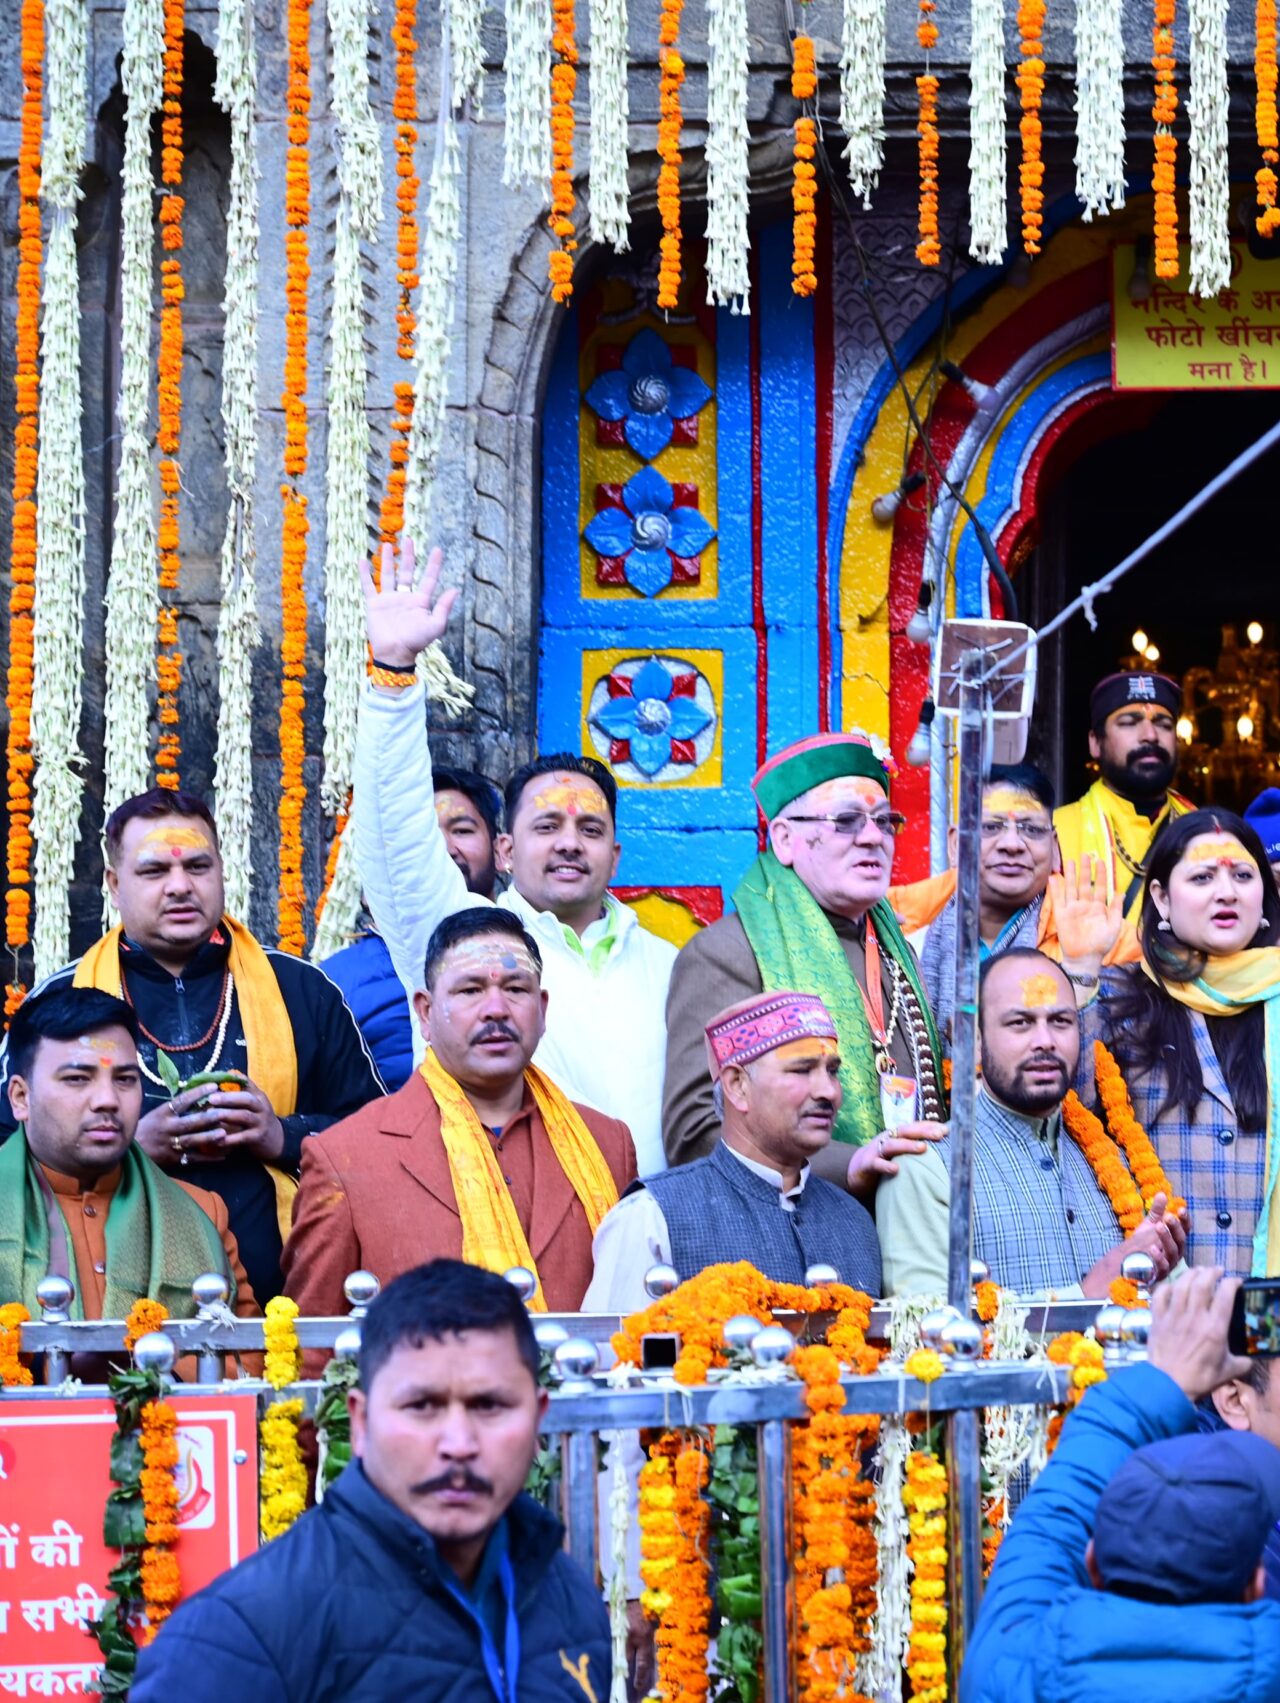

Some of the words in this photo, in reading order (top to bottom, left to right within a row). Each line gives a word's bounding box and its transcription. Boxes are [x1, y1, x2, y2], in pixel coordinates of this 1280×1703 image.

[1145, 319, 1205, 348] फोटो
[1188, 362, 1233, 381] मना
[29, 1519, 83, 1567] की
[20, 1583, 106, 1632] सभी
